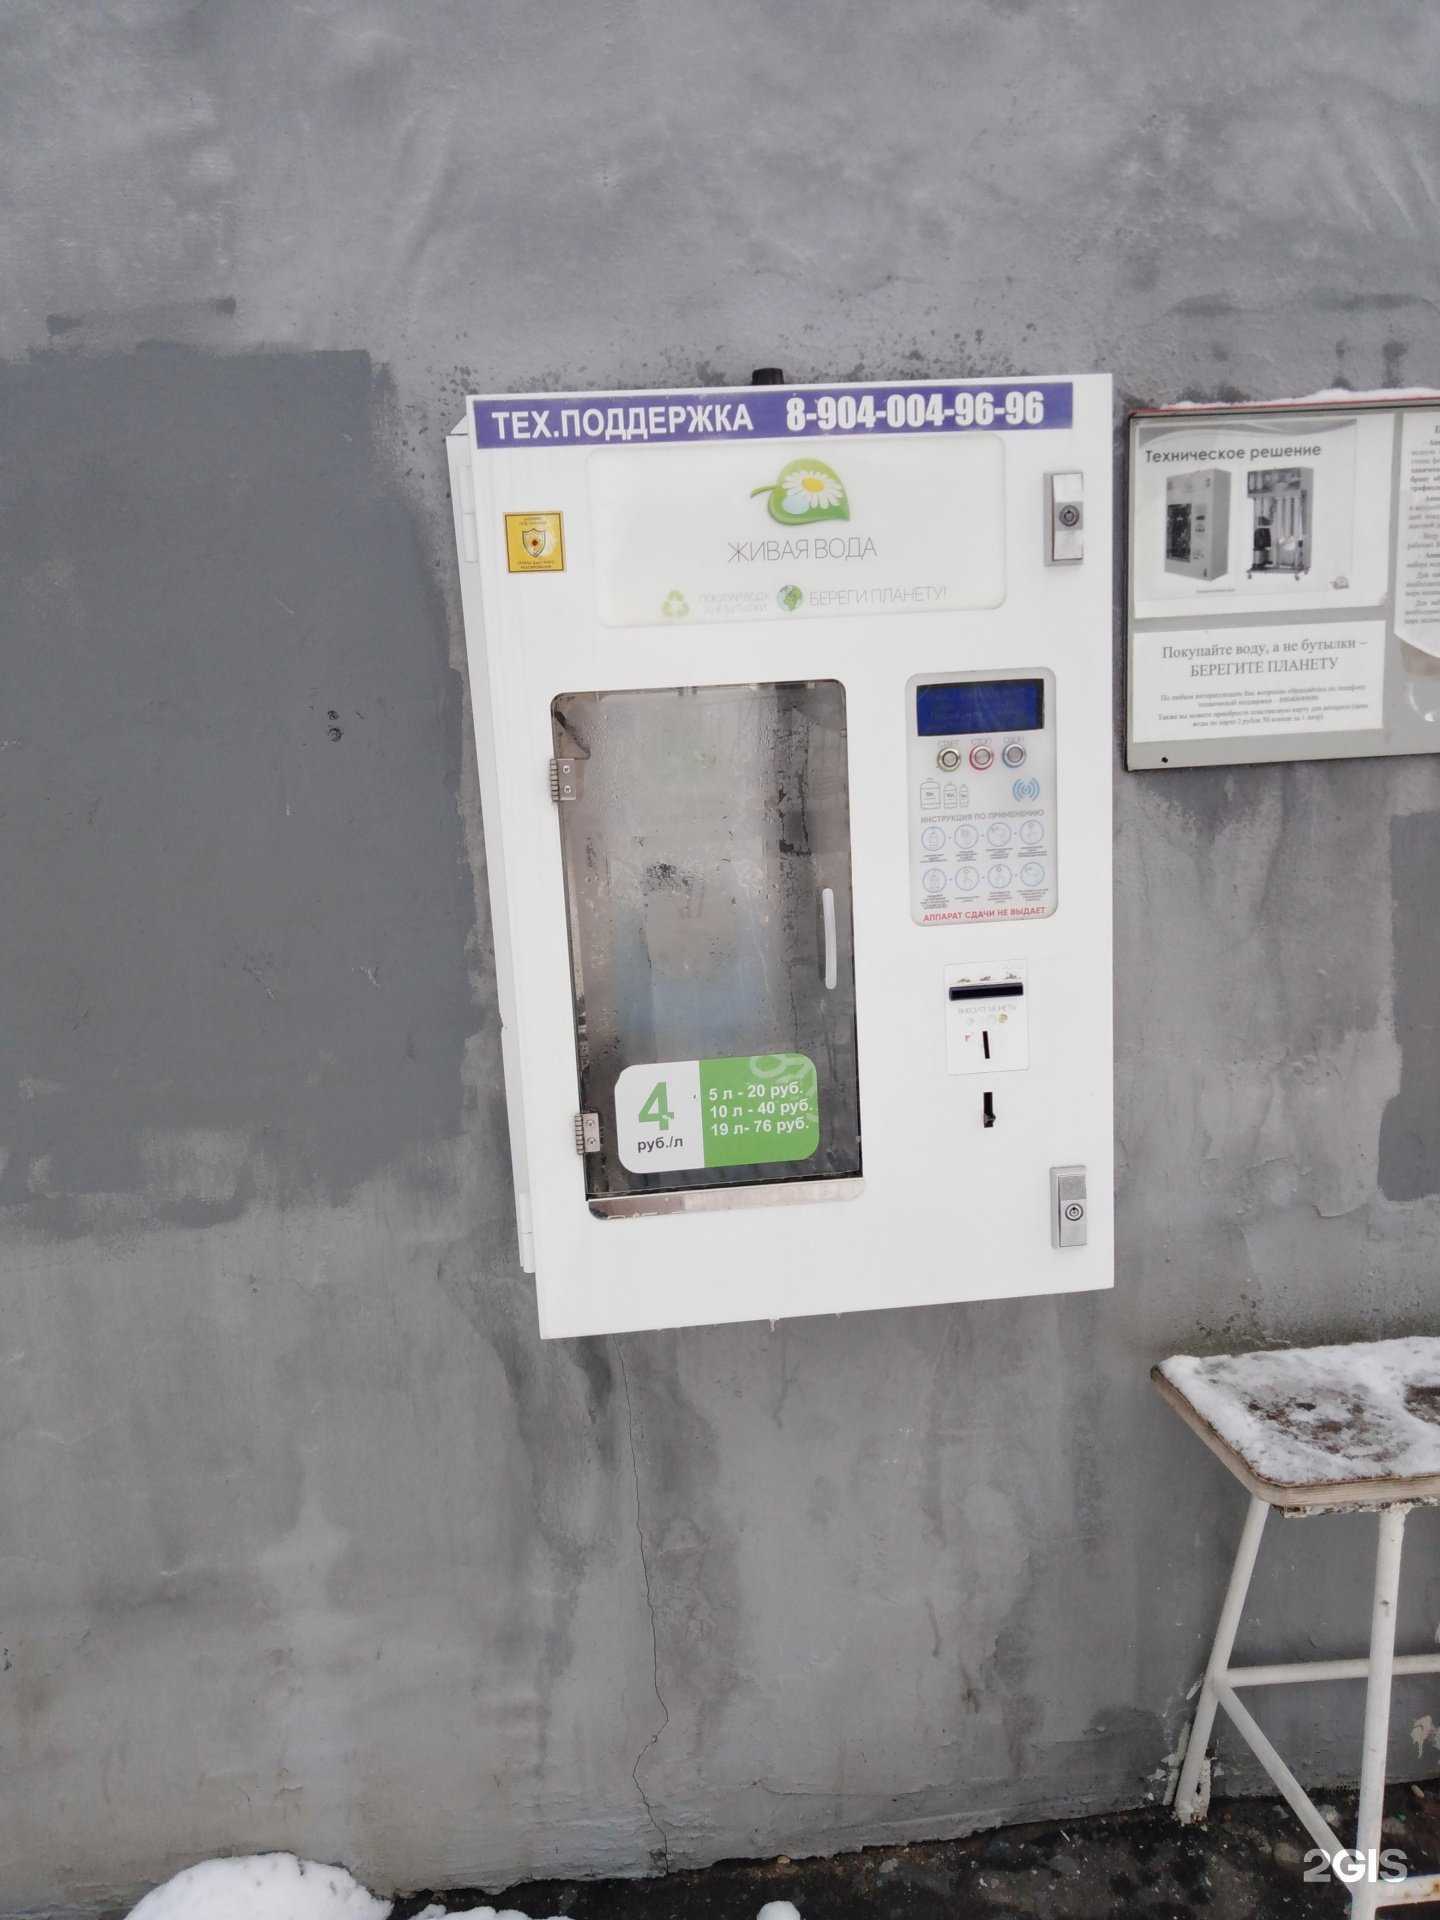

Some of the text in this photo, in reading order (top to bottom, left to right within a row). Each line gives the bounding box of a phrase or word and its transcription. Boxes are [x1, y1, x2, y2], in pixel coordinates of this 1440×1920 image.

[491, 391, 1044, 441] ТЕХ.ПОДДЕРЖКА 8-904-004-96-96
[1145, 445, 1322, 463] Техническое решение
[728, 537, 878, 563] ЖИВАЯ ВОДА
[809, 589, 868, 608] БЕРЕГИ
[1162, 643, 1232, 660] Покупайте
[1235, 644, 1270, 656] воду,
[1272, 643, 1280, 653] а
[1283, 642, 1299, 652] не
[1301, 638, 1356, 654] бутылки
[1190, 657, 1339, 678] БЕРЕГИТЕ ПЛАНЕТУ
[922, 906, 1046, 922] АППАРАТ СДАЧИ НЕ ВЫДАЕТ
[708, 1088, 718, 1101] 5
[722, 1090, 733, 1100] л
[747, 1084, 765, 1098] 20
[770, 1081, 803, 1099] руб.
[638, 1081, 675, 1131] 4
[710, 1105, 728, 1119] 10
[732, 1107, 743, 1118] л
[757, 1101, 775, 1115] 40
[780, 1098, 813, 1116] руб.
[711, 1122, 729, 1136] 19
[753, 1119, 772, 1133] 76
[777, 1116, 809, 1134] руб.
[637, 1137, 684, 1154] руб./л
